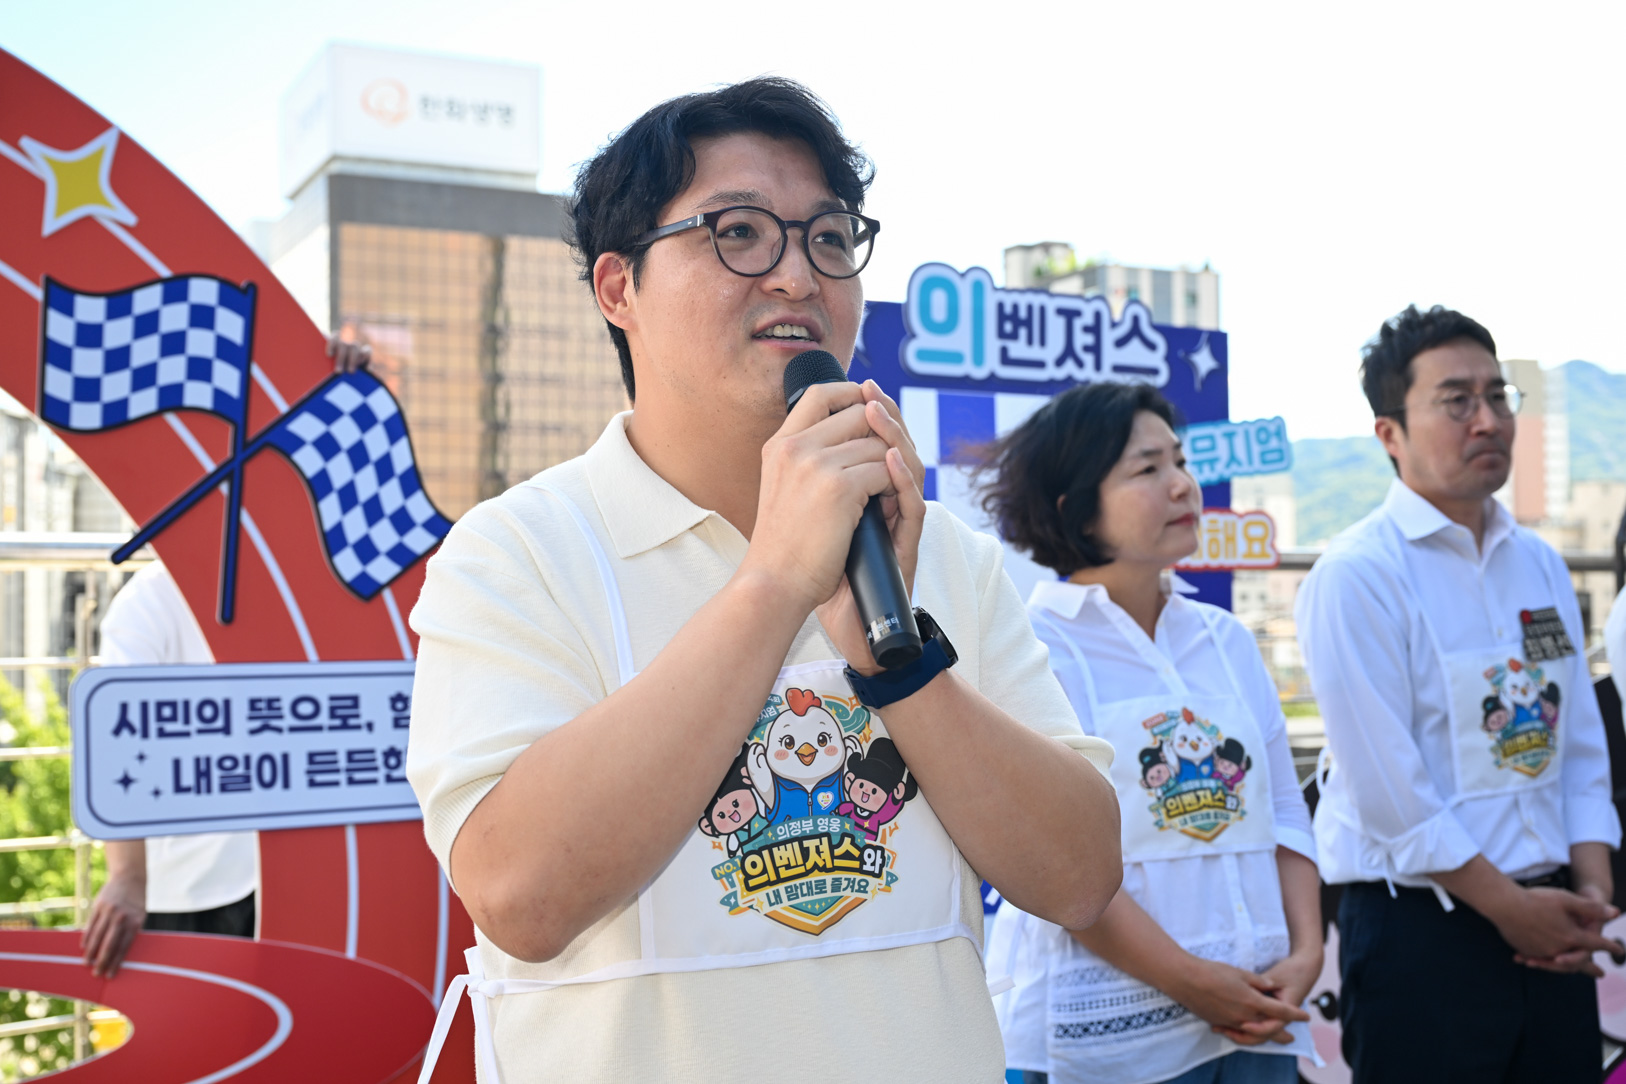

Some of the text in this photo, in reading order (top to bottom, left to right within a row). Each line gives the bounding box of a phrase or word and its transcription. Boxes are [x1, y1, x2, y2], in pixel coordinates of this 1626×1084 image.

[915, 275, 1160, 375] 의벤져스
[1190, 425, 1285, 474] 뮤지엄
[1192, 518, 1272, 560] 해요
[111, 698, 232, 740] 시민의
[246, 694, 374, 736] 뜻으로,
[756, 705, 778, 723] 지엄
[172, 752, 291, 796] 내일이
[776, 817, 841, 840] 의정부 영웅
[714, 858, 741, 878] NO.1
[744, 836, 883, 887] 의벤져스와
[765, 876, 870, 907] 내 맘대로 즐겨요
